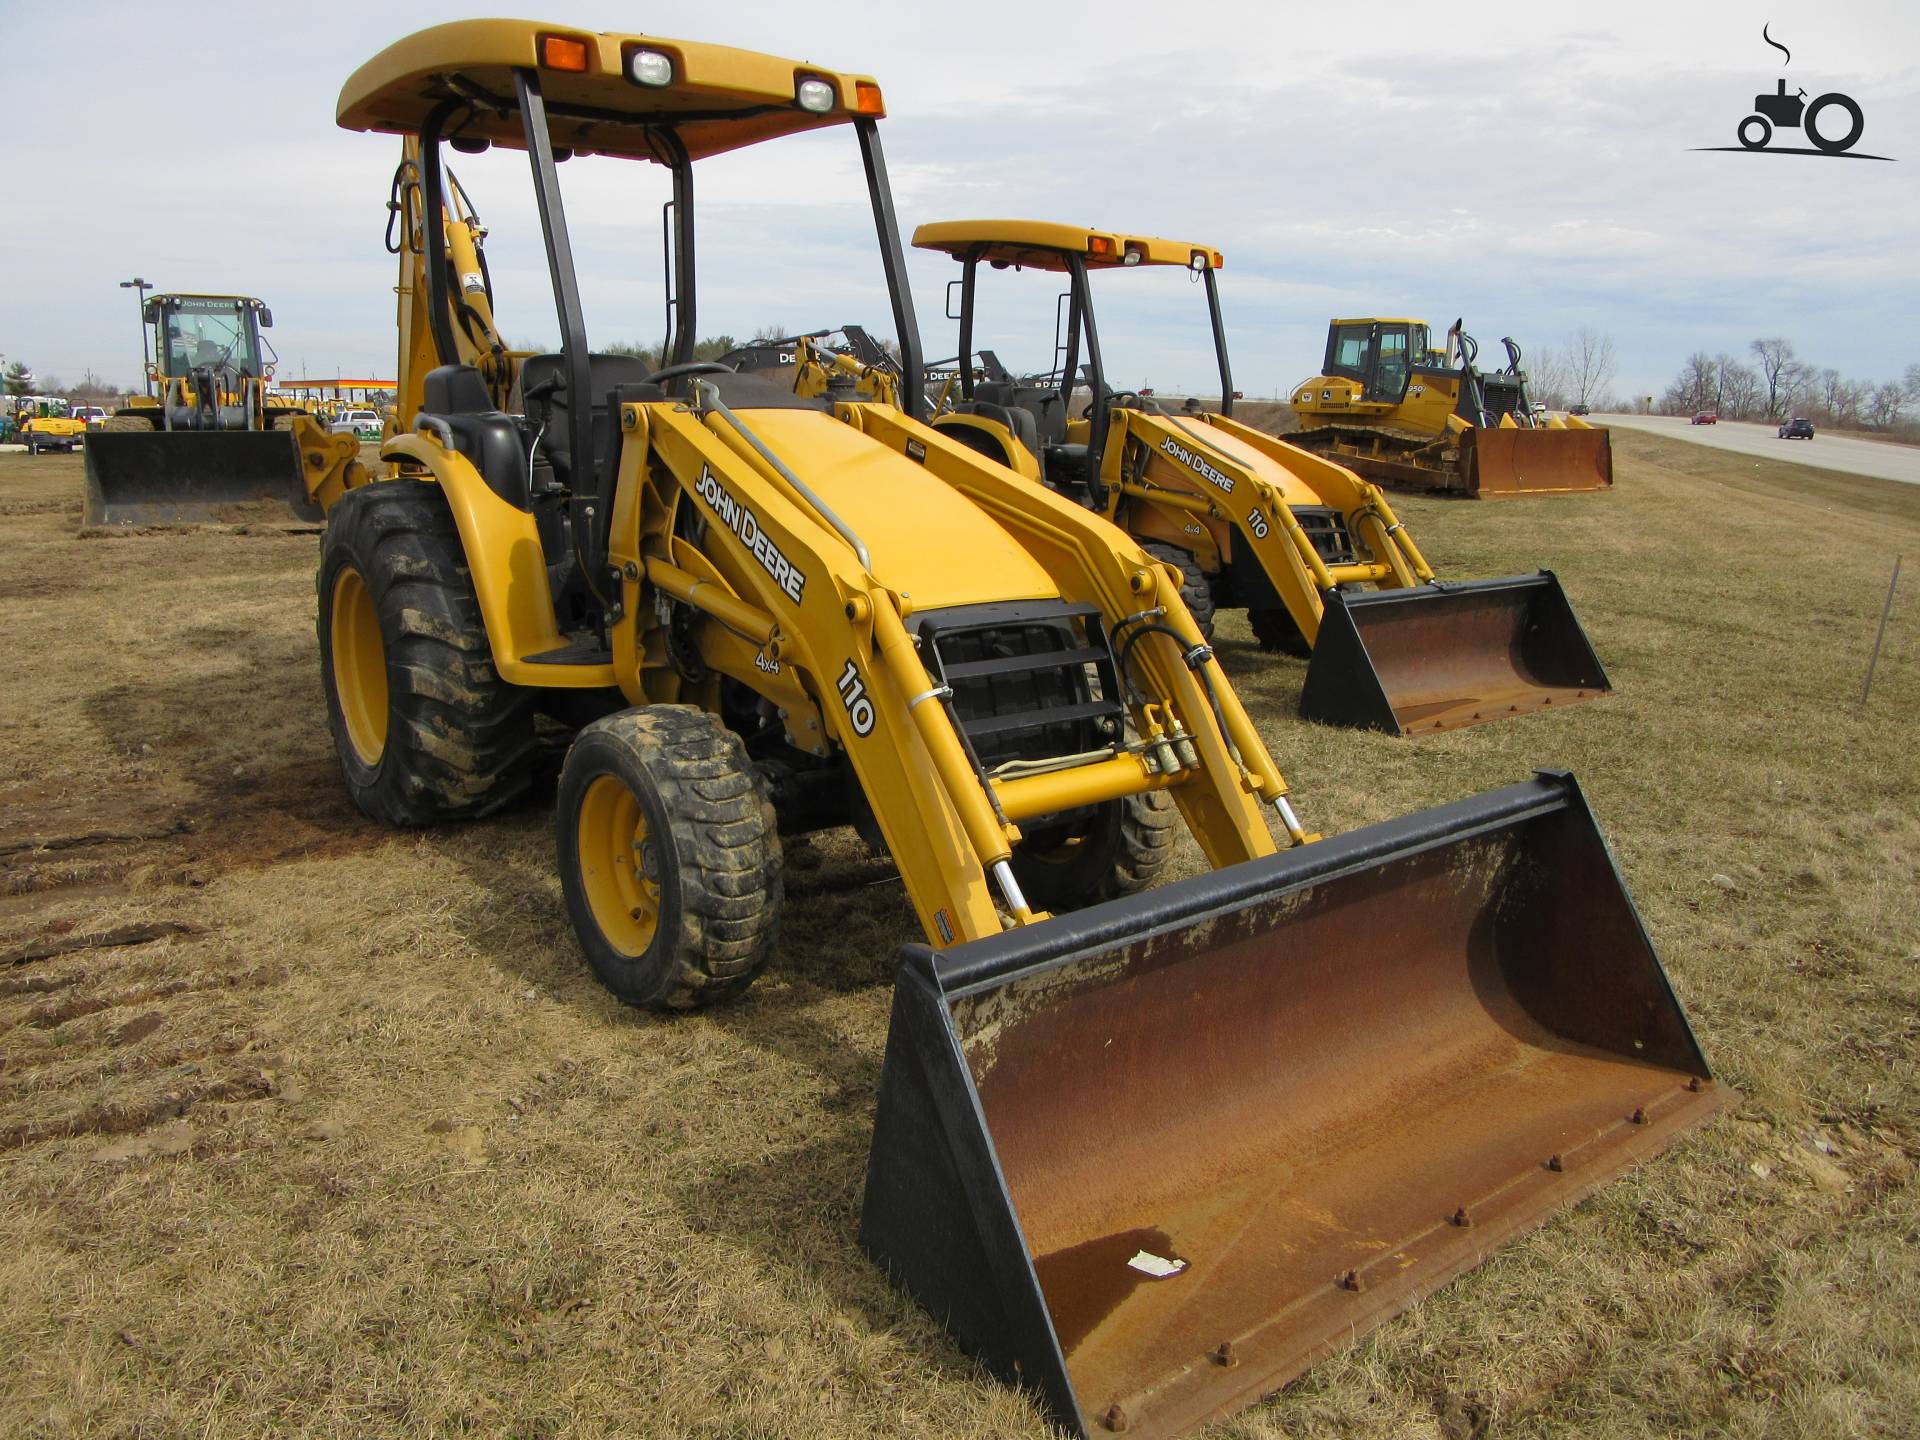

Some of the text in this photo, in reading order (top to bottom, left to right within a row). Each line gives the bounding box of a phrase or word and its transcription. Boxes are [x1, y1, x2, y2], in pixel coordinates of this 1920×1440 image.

[1160, 436, 1234, 493] JOHN DEERE
[695, 466, 806, 603] JOHN DEERE
[1247, 508, 1268, 538] 110
[837, 660, 875, 735] 110
